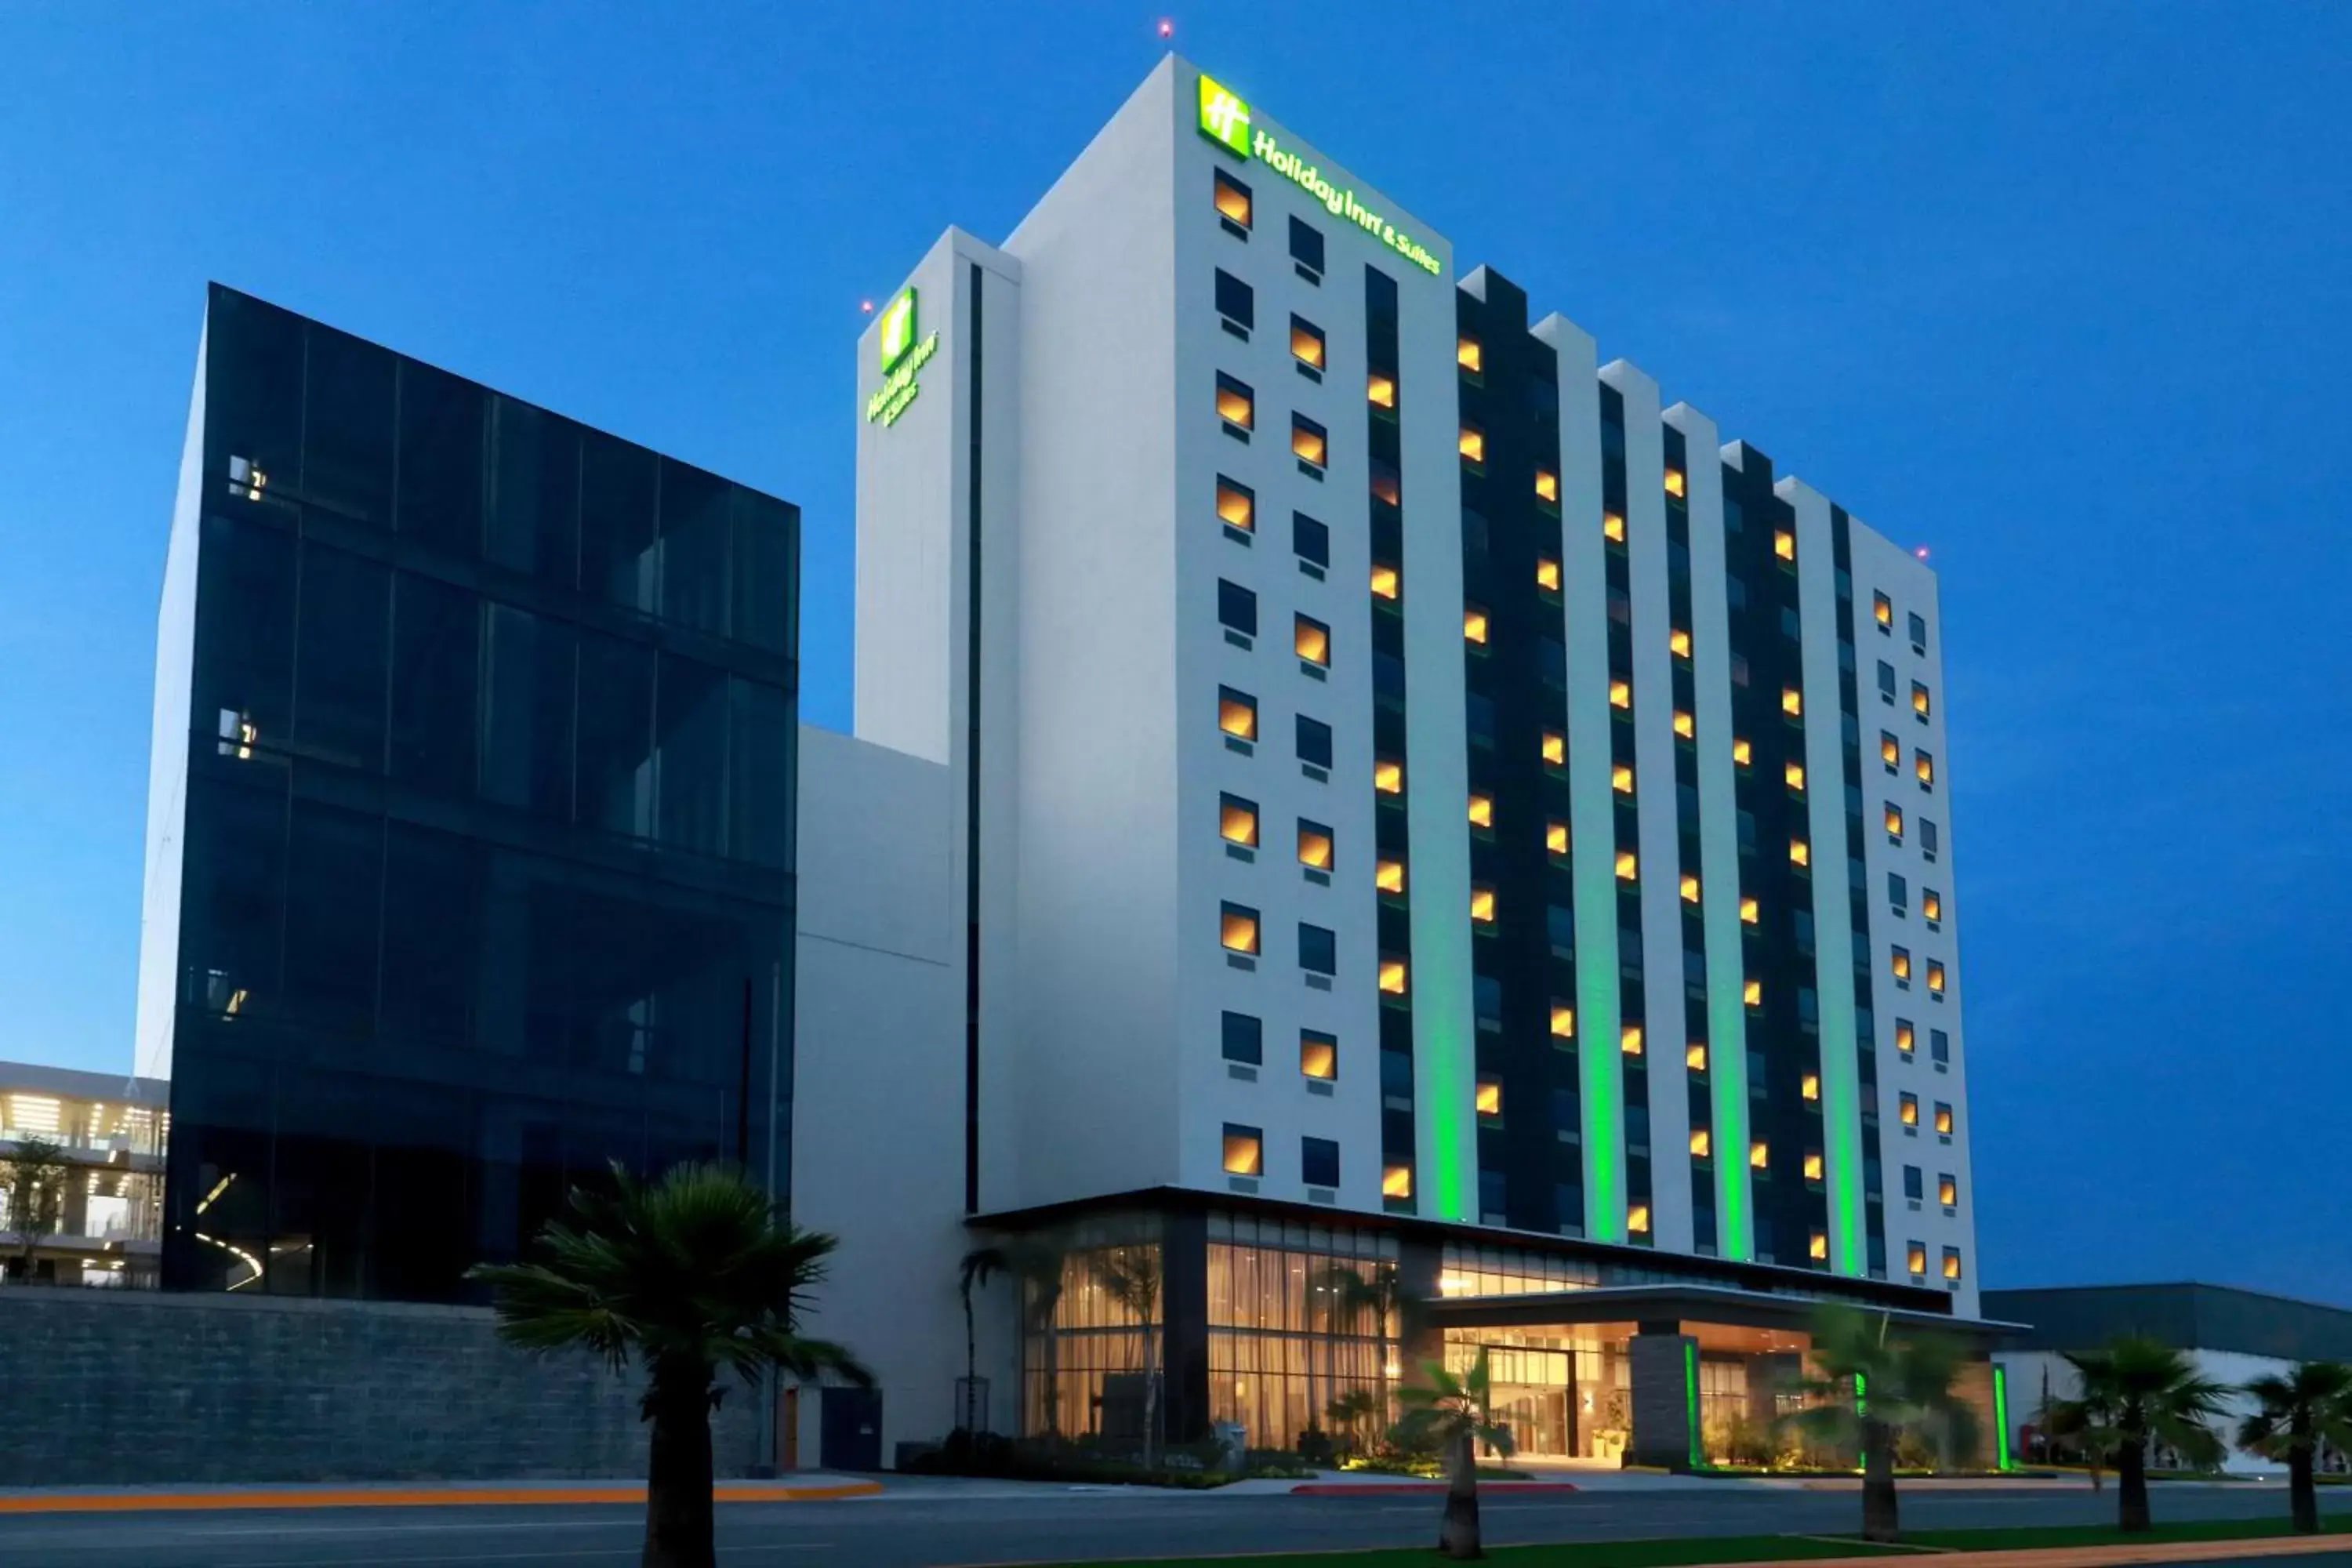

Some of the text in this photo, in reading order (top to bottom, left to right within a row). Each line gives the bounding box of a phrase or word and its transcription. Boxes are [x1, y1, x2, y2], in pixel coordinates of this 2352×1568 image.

[1253, 129, 1440, 276] Holiday Inn & Suites
